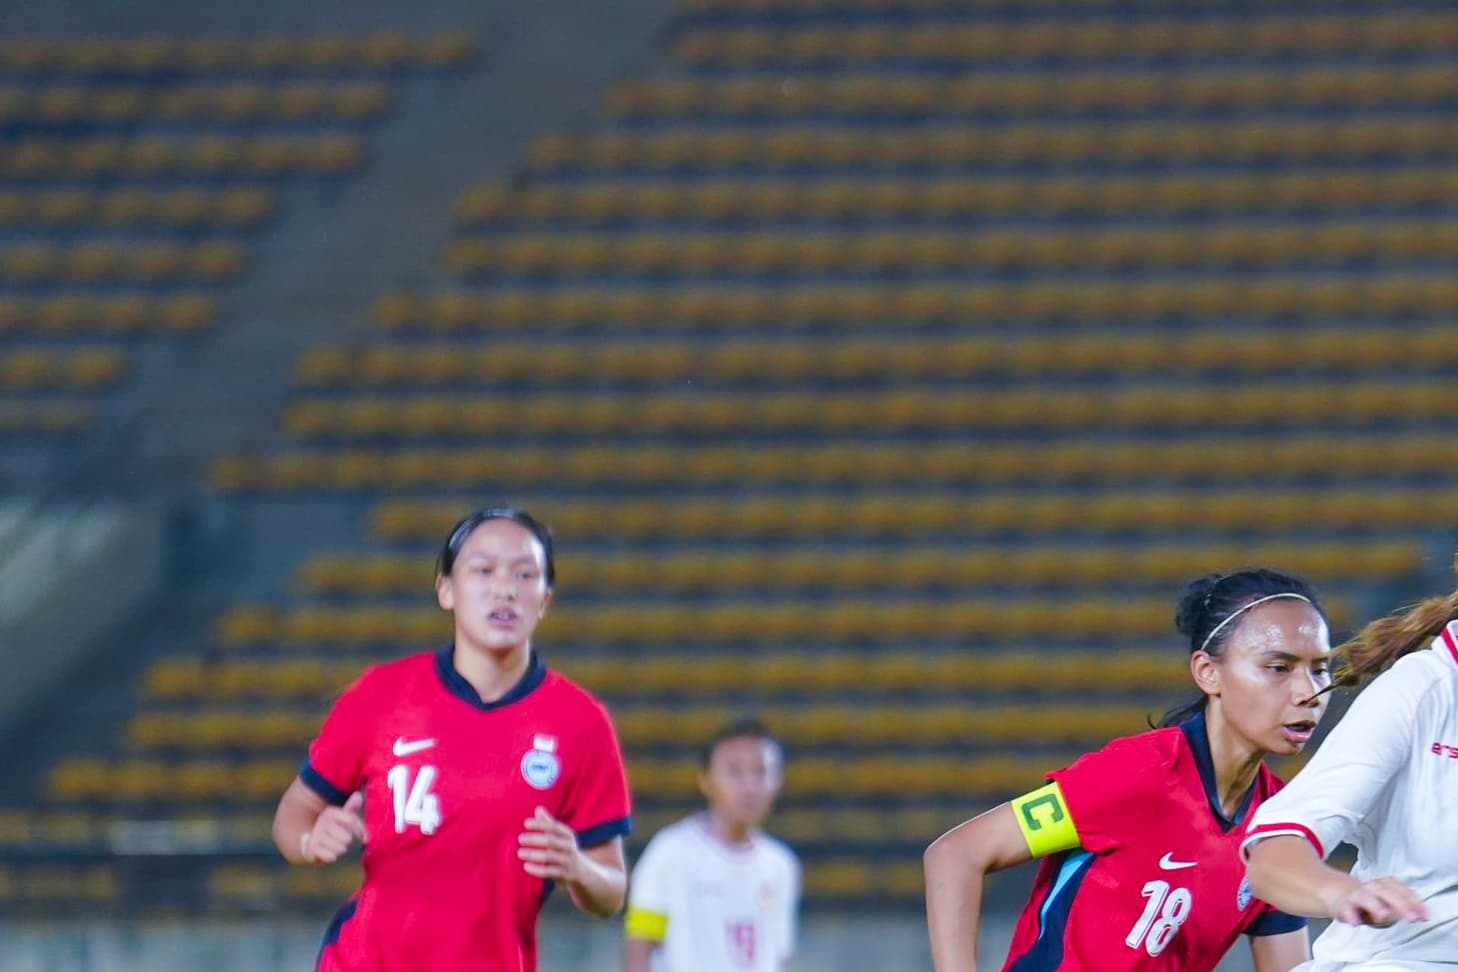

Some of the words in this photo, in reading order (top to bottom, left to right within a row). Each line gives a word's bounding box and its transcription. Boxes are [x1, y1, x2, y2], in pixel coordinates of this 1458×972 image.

[387, 765, 442, 835] 14
[1021, 792, 1064, 831] C
[1125, 880, 1193, 957] 18
